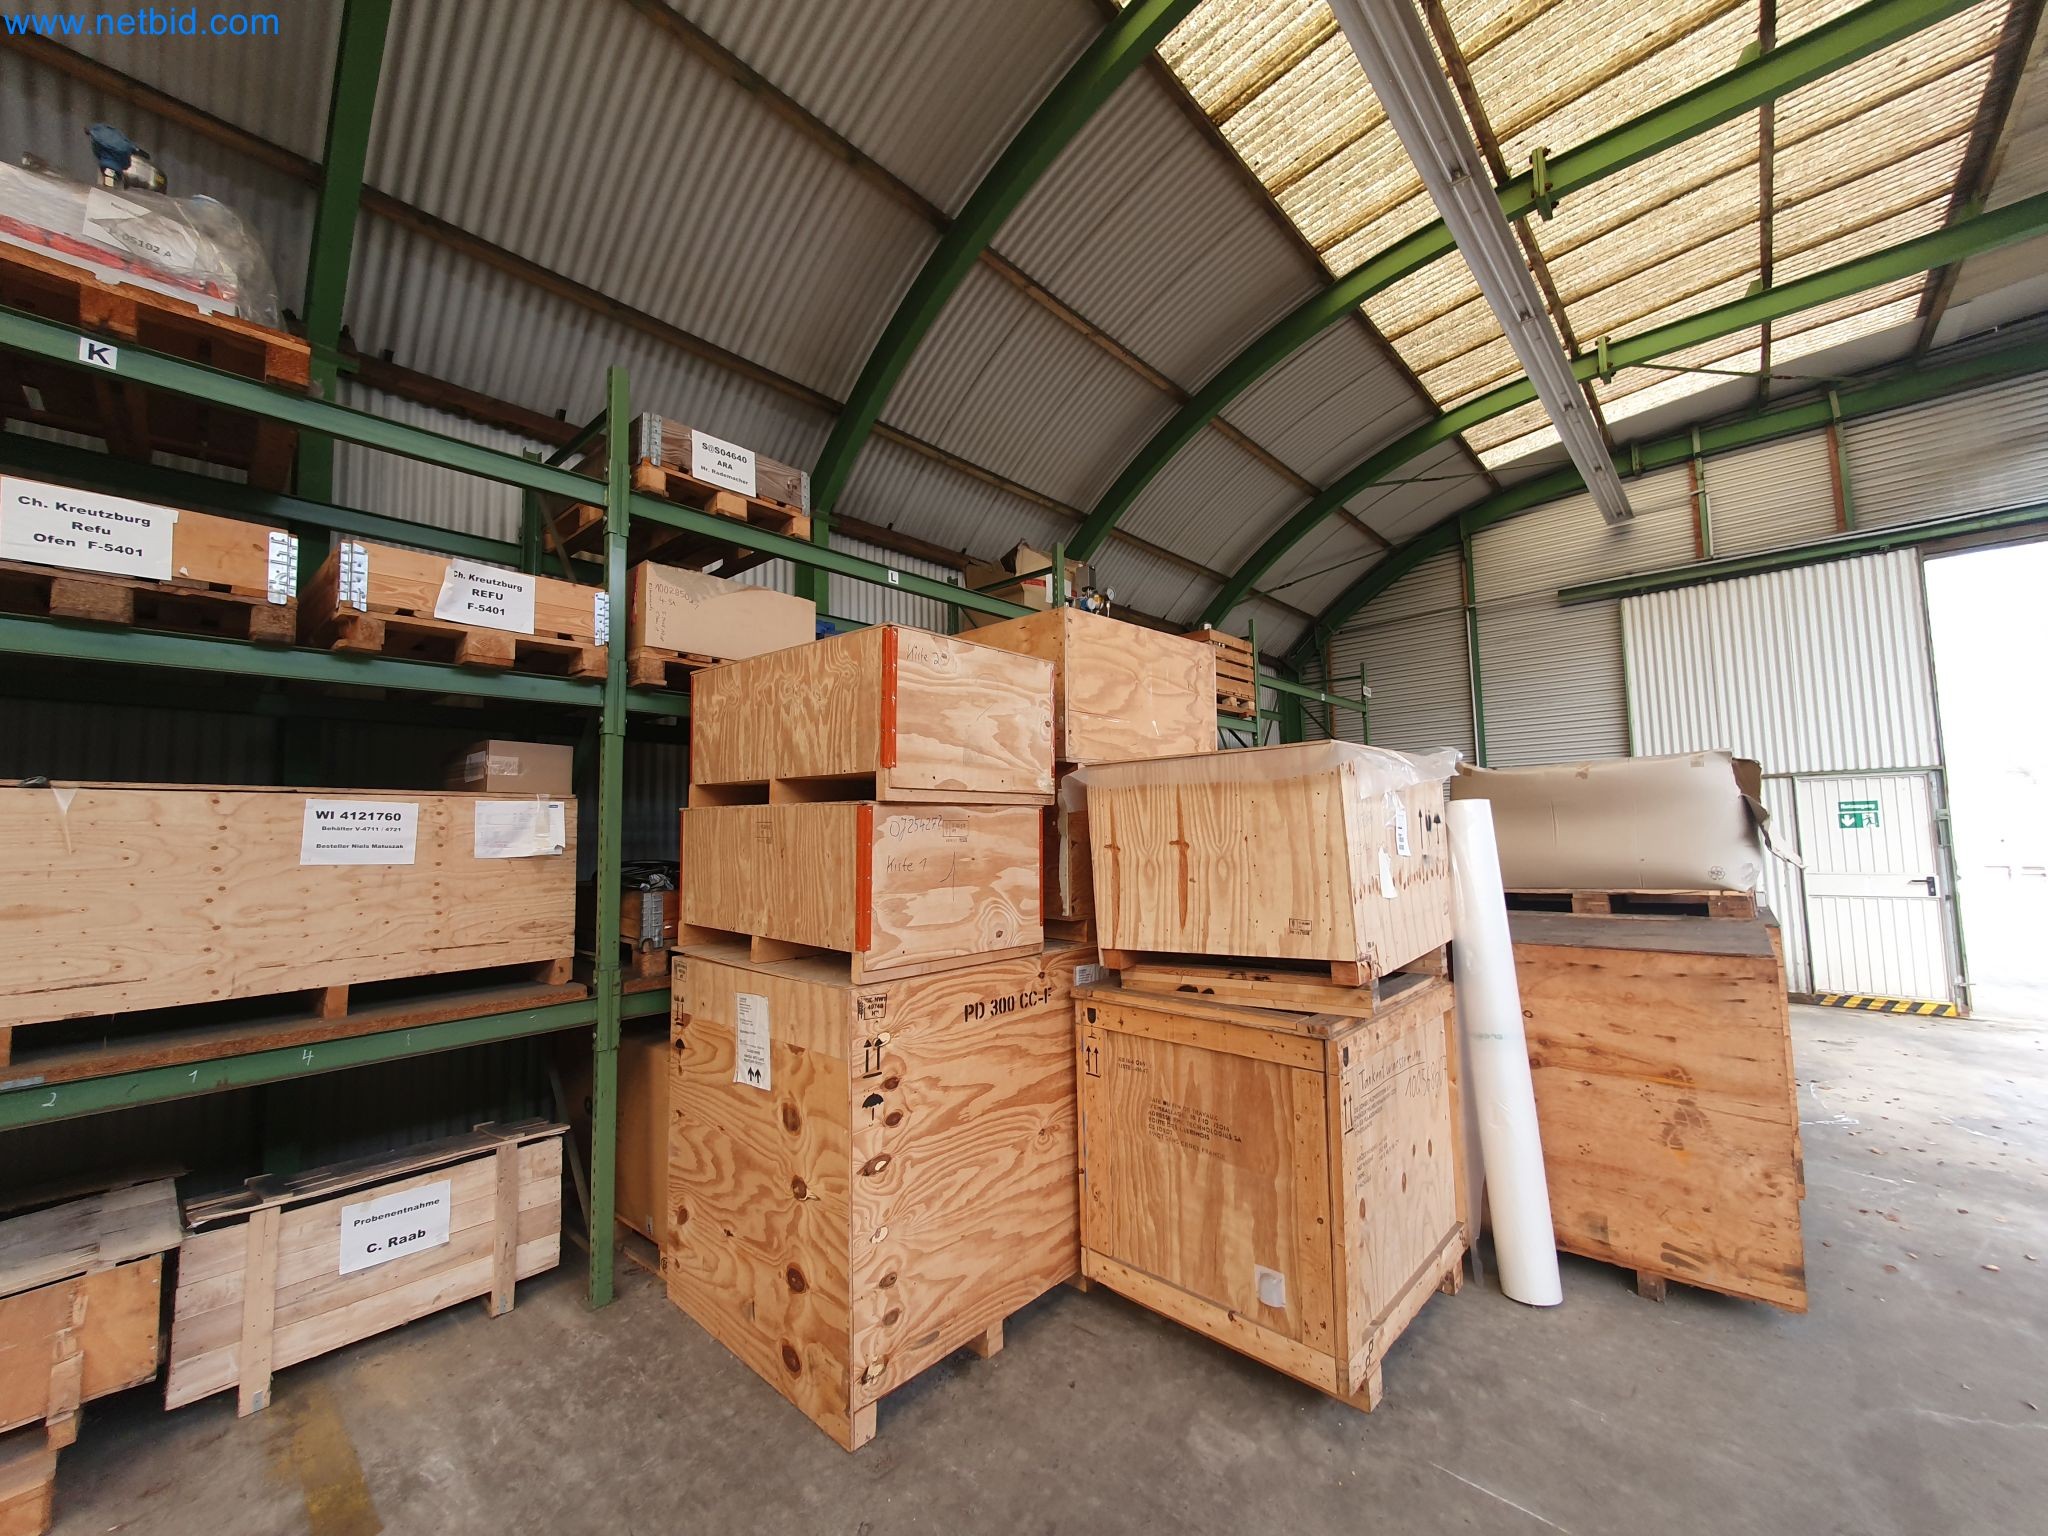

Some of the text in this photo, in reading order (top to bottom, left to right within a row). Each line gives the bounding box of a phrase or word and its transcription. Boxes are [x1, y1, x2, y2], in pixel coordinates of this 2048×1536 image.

[88, 343, 110, 365] K
[717, 460, 733, 470] ARA
[711, 468, 748, 485] Rademacher
[18, 496, 151, 527] Ch. Kreutzburg
[72, 521, 111, 535] Refu
[33, 533, 143, 556] Ofen F-5401
[454, 570, 523, 592] Ch. Kreutzburg
[891, 572, 896, 582] L
[472, 588, 503, 600] REFU
[467, 602, 505, 615] F-5401
[931, 652, 940, 664] 2
[316, 811, 401, 821] WI 4121760
[886, 855, 927, 873] Kiste 1
[964, 987, 1052, 1022] PD 300 CC-F
[302, 1049, 314, 1066] 4
[41, 1092, 57, 1107] 2
[353, 1199, 440, 1227] Probenentnahme
[366, 1229, 426, 1253] C. Raab
